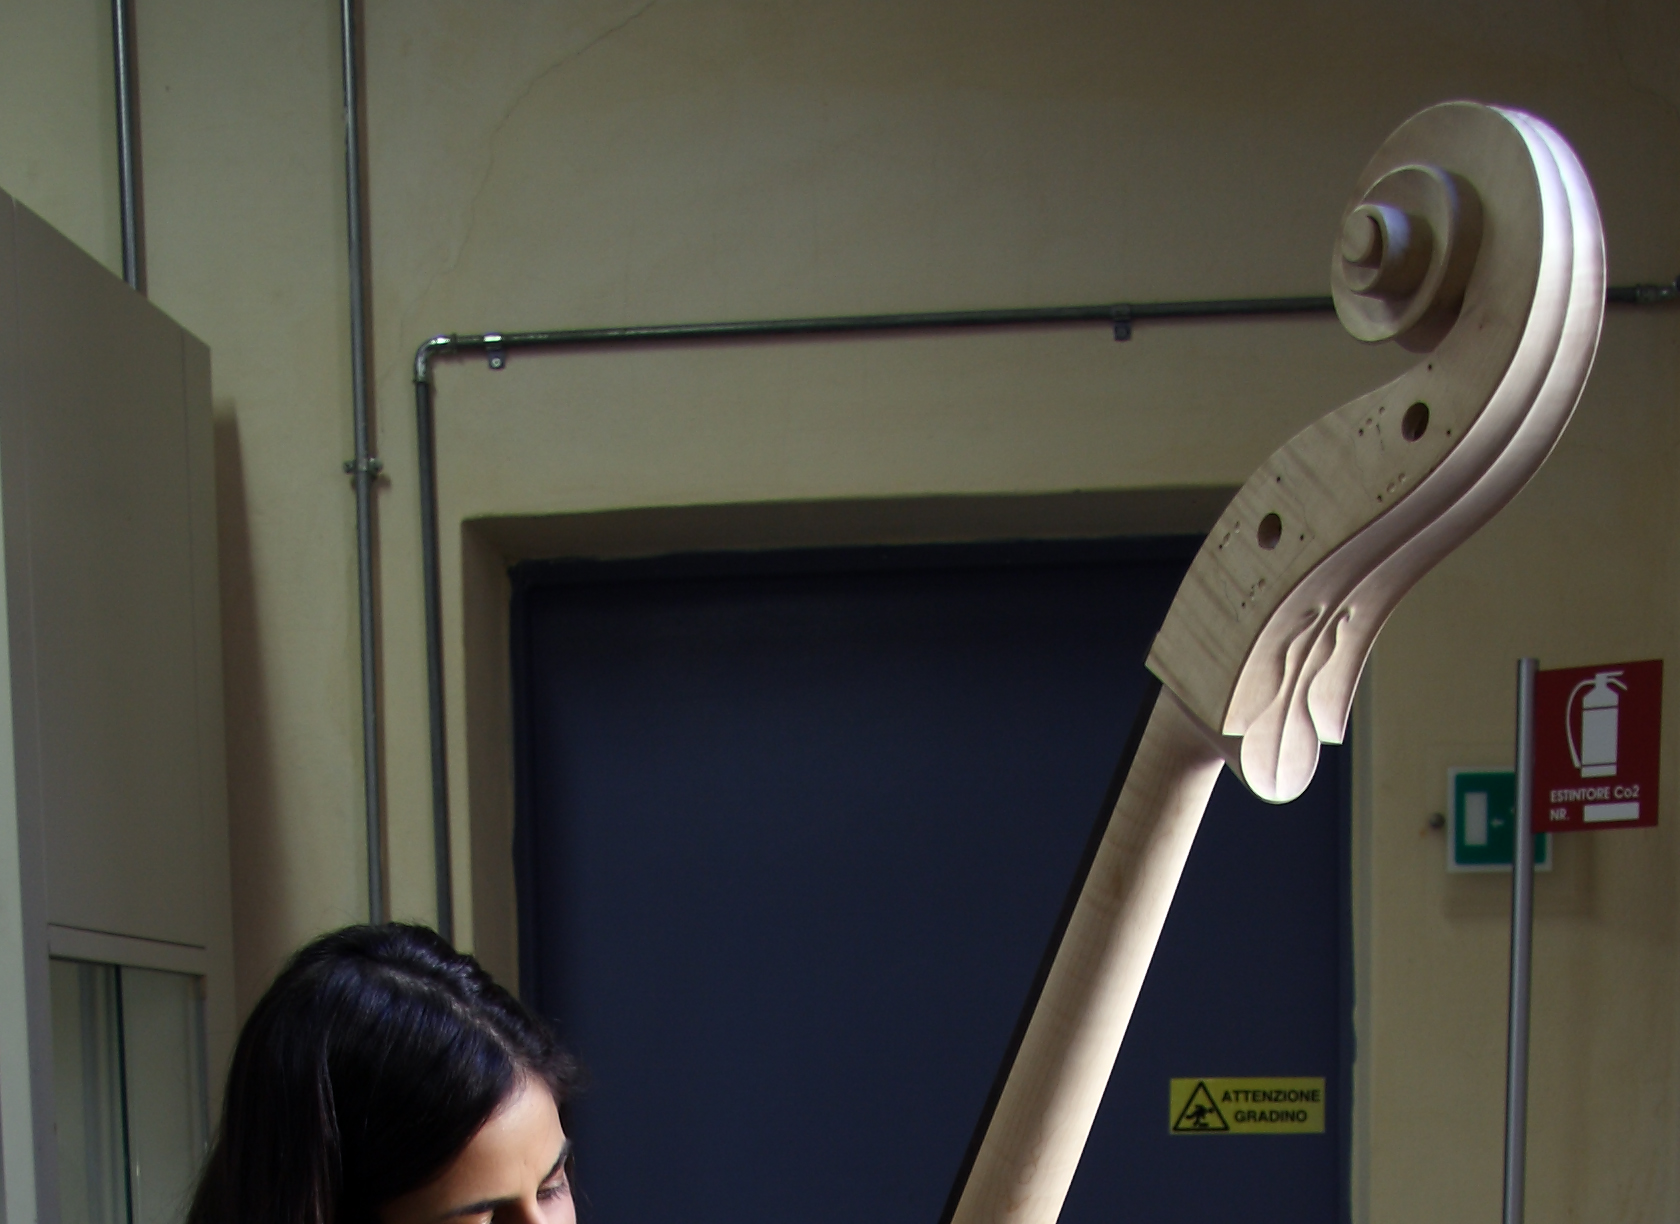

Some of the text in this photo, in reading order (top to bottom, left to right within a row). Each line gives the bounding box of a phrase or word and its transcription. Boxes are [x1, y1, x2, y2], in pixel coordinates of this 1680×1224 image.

[1550, 784, 1640, 803] ESTINTORE Co2
[1222, 1089, 1321, 1103] ATTENZIONE
[1234, 1110, 1308, 1123] GRADINO
